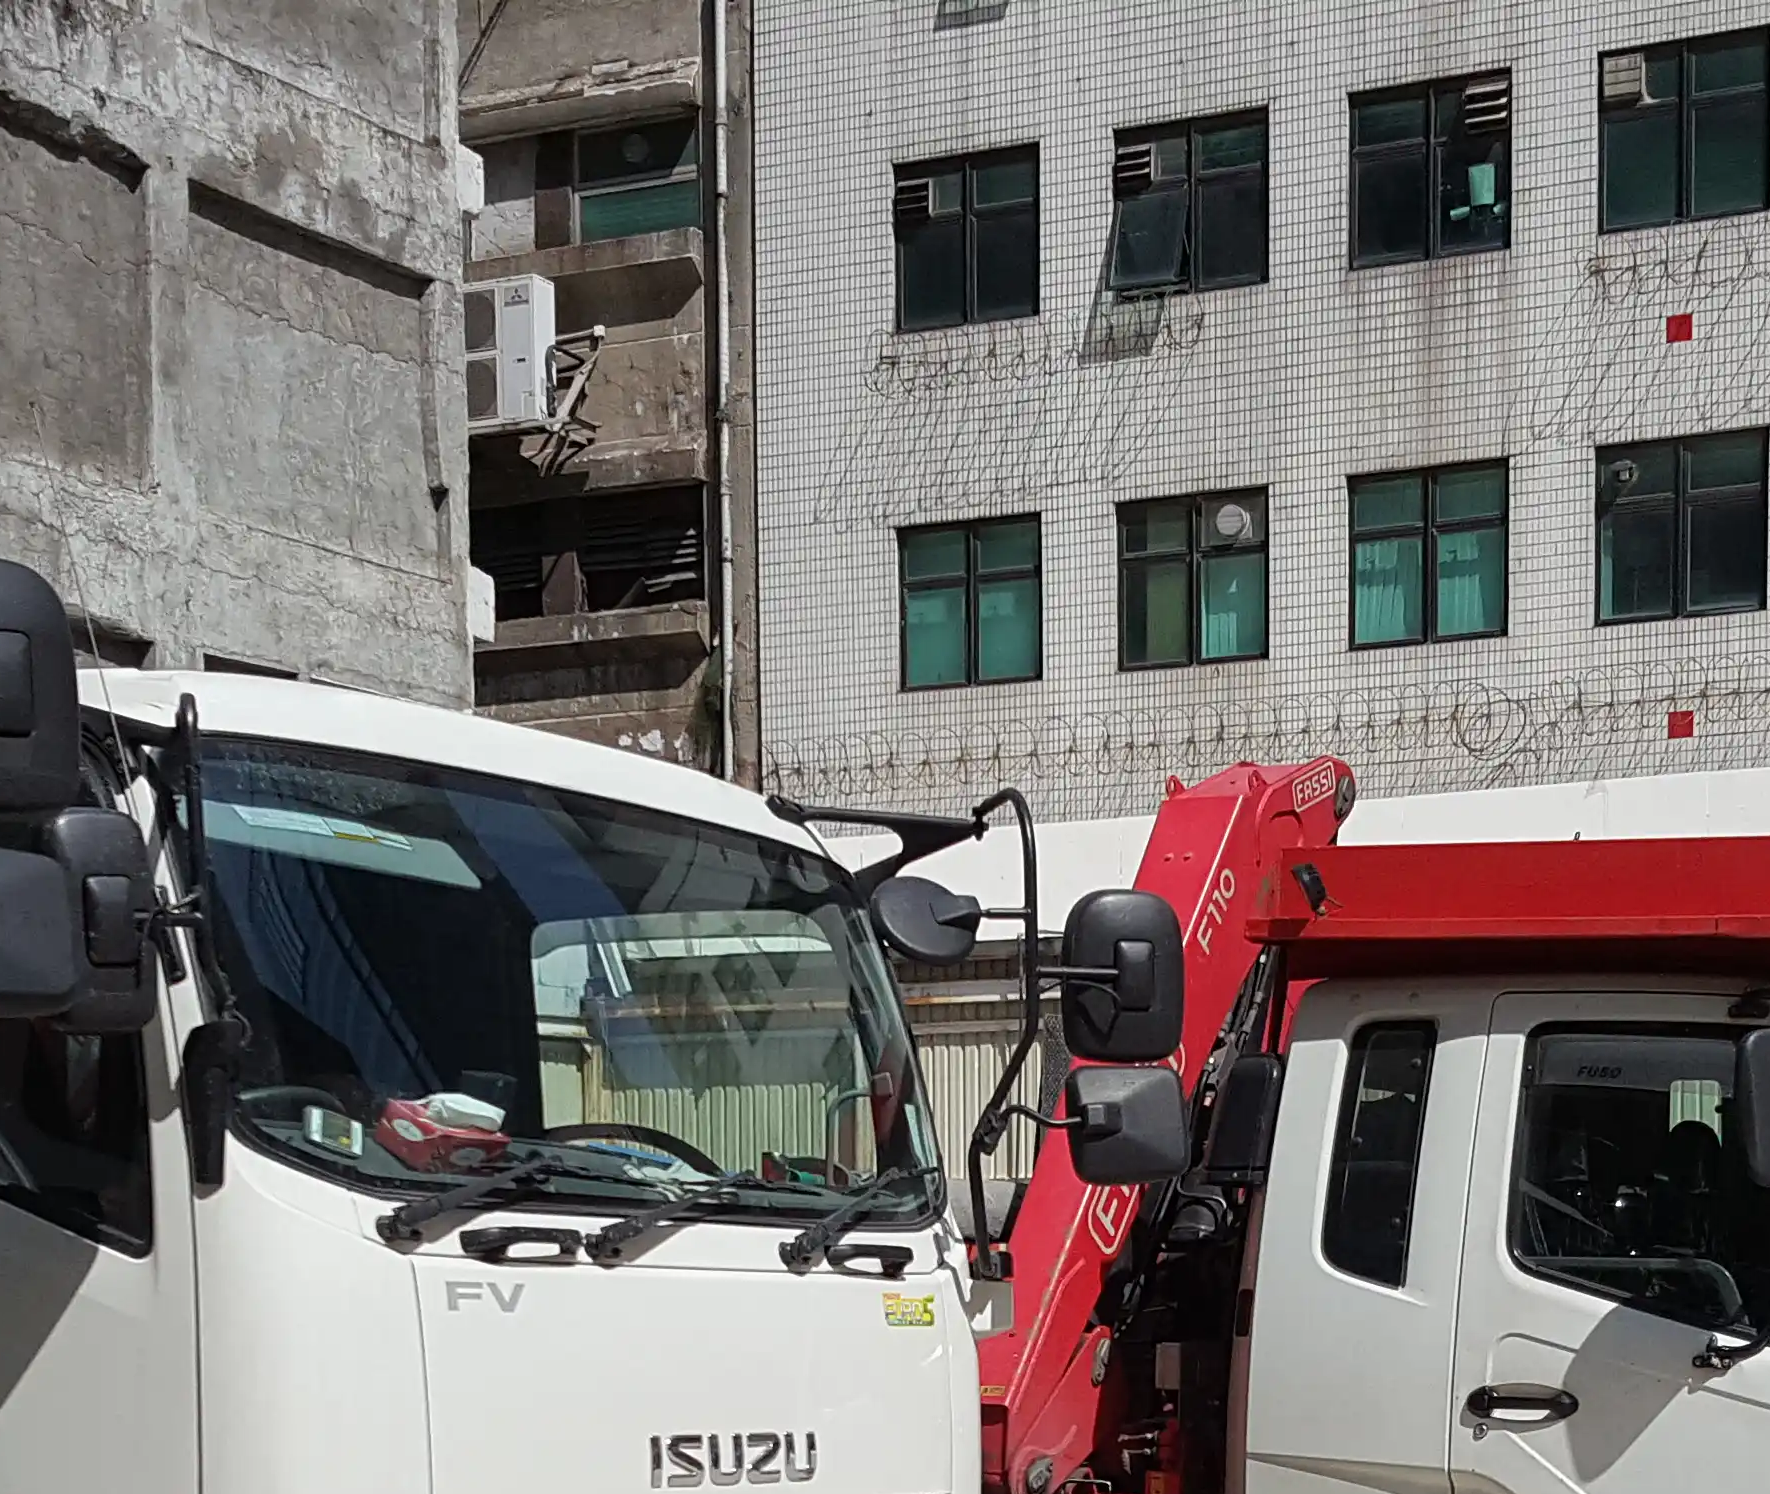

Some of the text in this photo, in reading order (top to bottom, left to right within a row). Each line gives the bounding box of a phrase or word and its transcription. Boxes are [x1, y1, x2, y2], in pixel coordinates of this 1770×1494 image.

[1296, 769, 1332, 805] FASSI
[1196, 868, 1235, 955] F110
[1576, 1064, 1623, 1079] FUSO
[445, 1281, 525, 1313] FV
[649, 1431, 818, 1490] ISUZU
